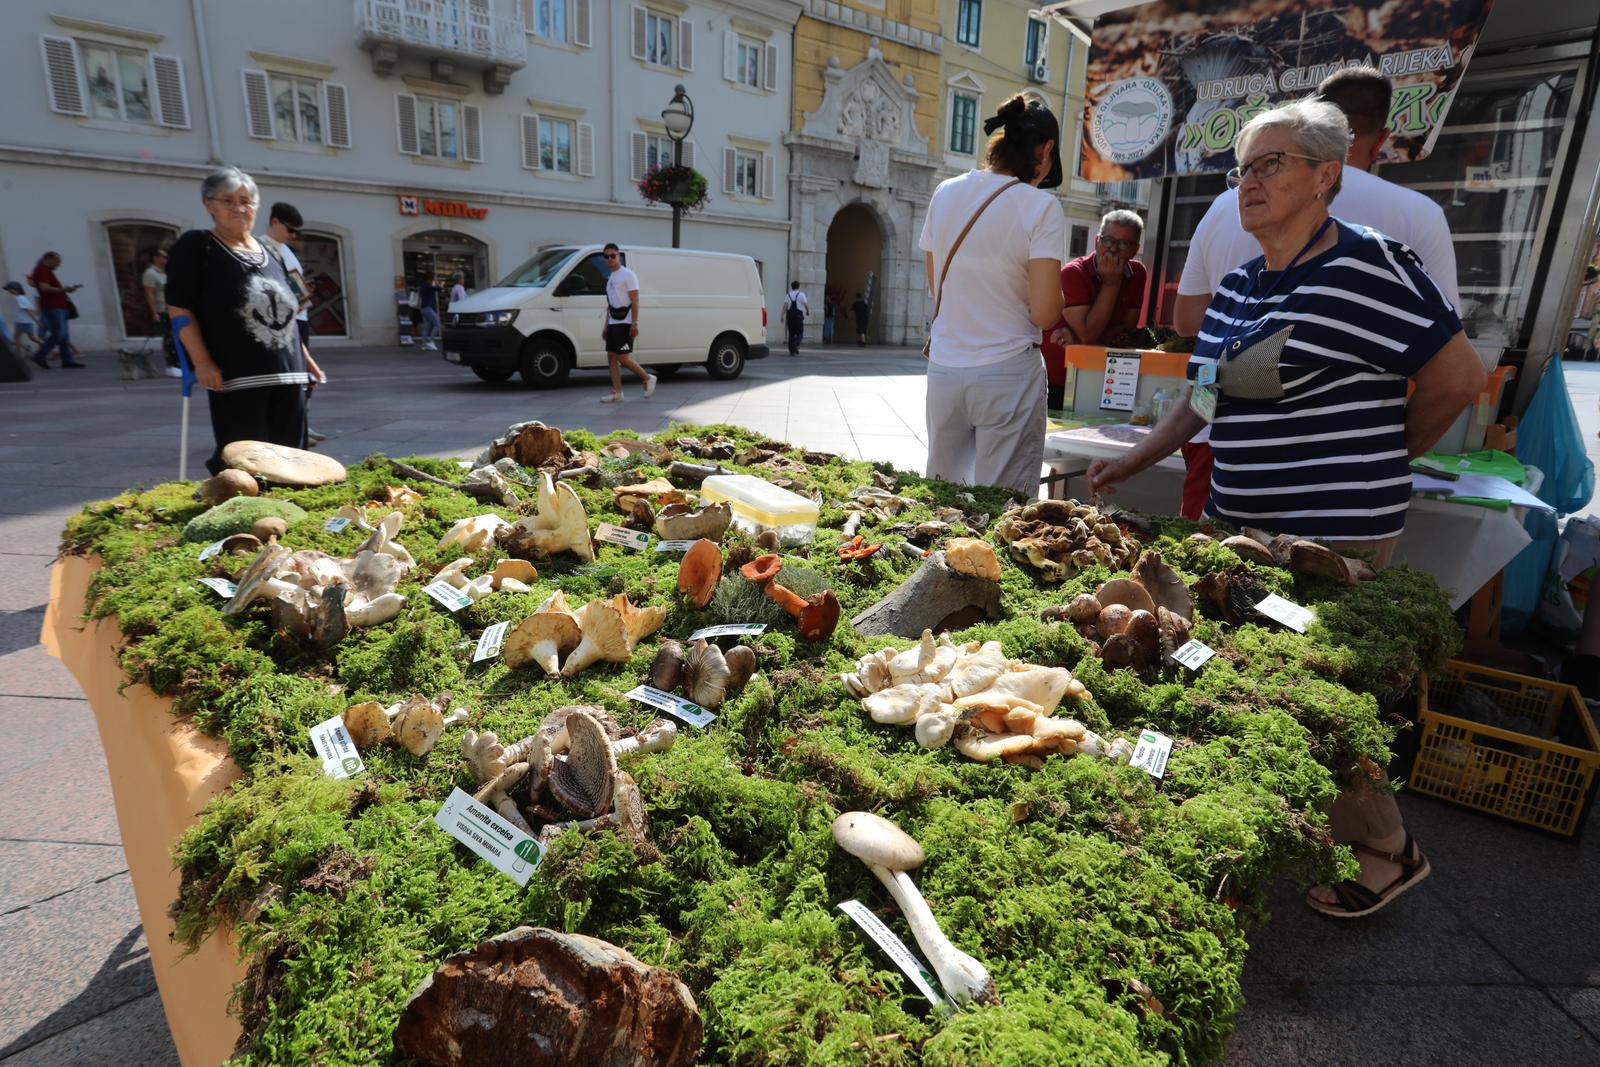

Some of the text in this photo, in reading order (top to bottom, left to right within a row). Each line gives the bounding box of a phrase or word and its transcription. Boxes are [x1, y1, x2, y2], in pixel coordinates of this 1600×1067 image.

[1198, 70, 1276, 102] UDRUGA
[1380, 41, 1456, 77] RIJEKA
[1100, 81, 1137, 112] GLJIVARA
[1095, 112, 1108, 150] UDRUGA
[1149, 113, 1169, 145] RIJEKA
[344, 759, 357, 771] ne
[455, 820, 502, 857] VISOKA SIVA MUHARA
[465, 803, 515, 842] Amanita excelsa
